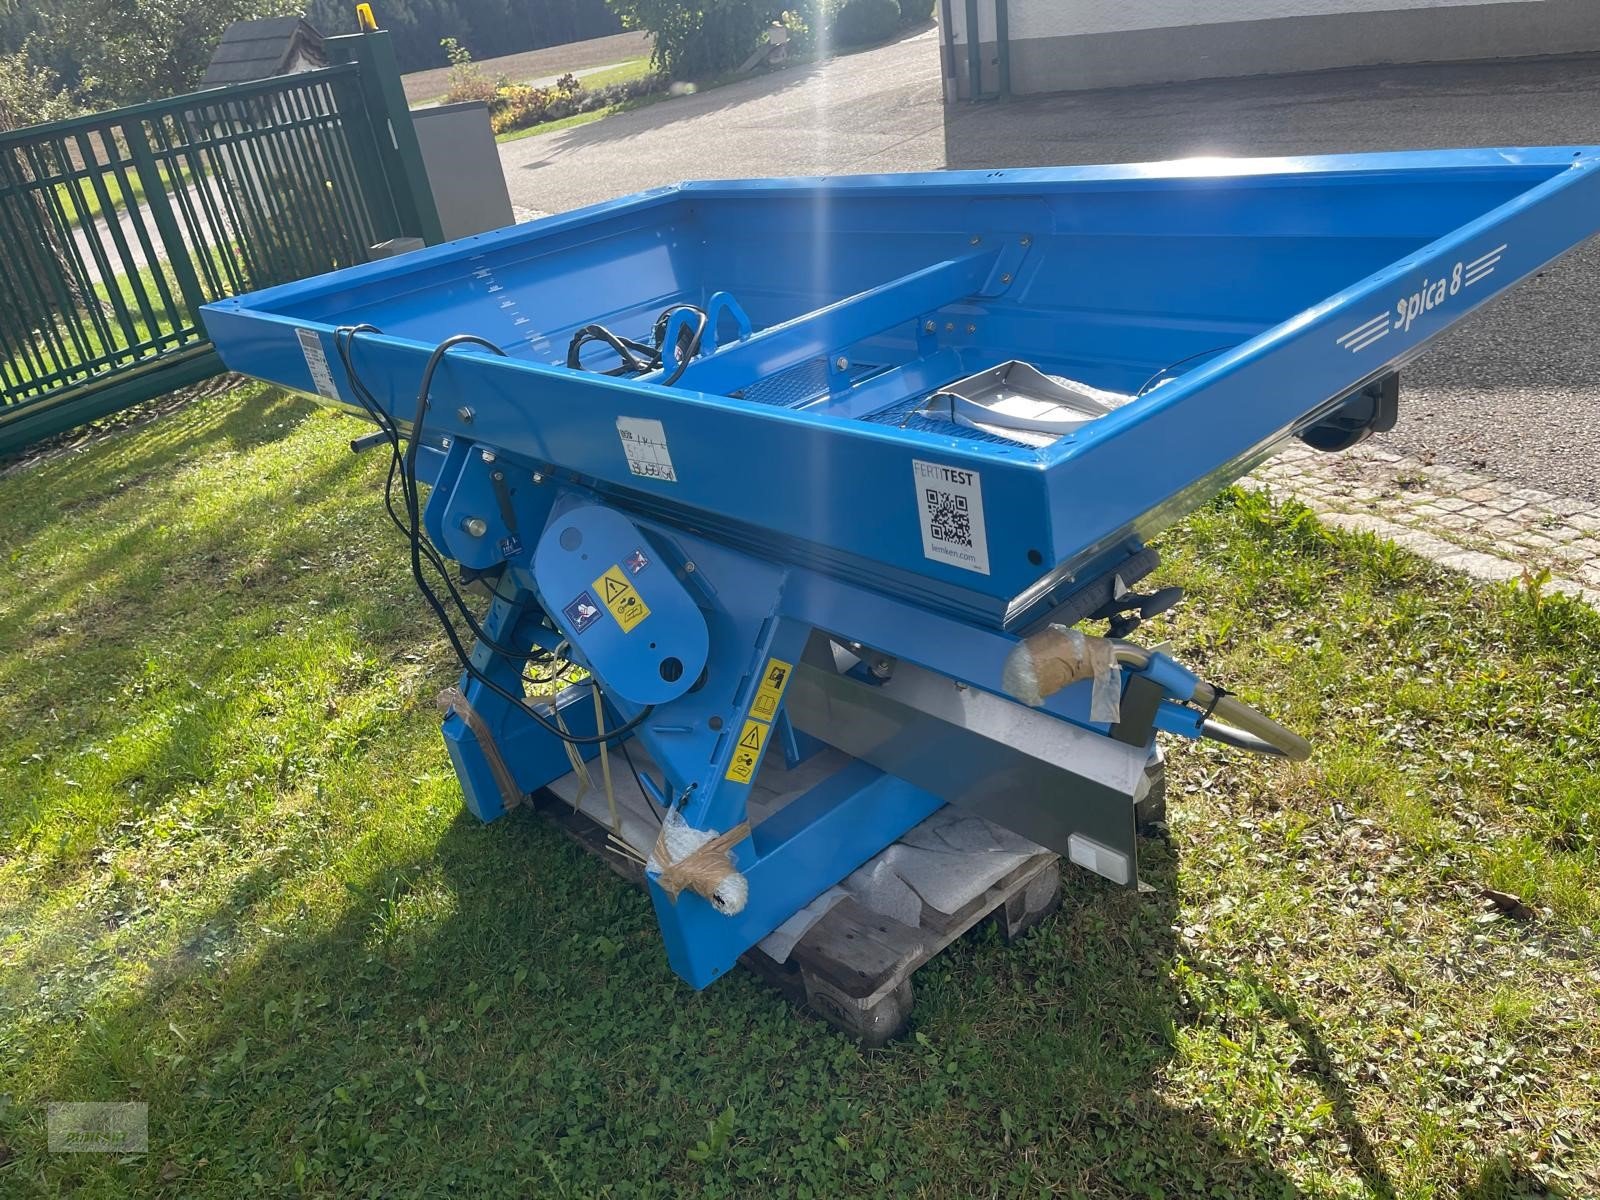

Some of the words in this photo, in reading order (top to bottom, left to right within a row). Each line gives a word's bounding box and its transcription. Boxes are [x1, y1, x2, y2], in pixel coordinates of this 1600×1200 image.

[1449, 262, 1463, 296] 8
[914, 462, 973, 486] FERTITEST
[931, 543, 976, 562] lemken.com
